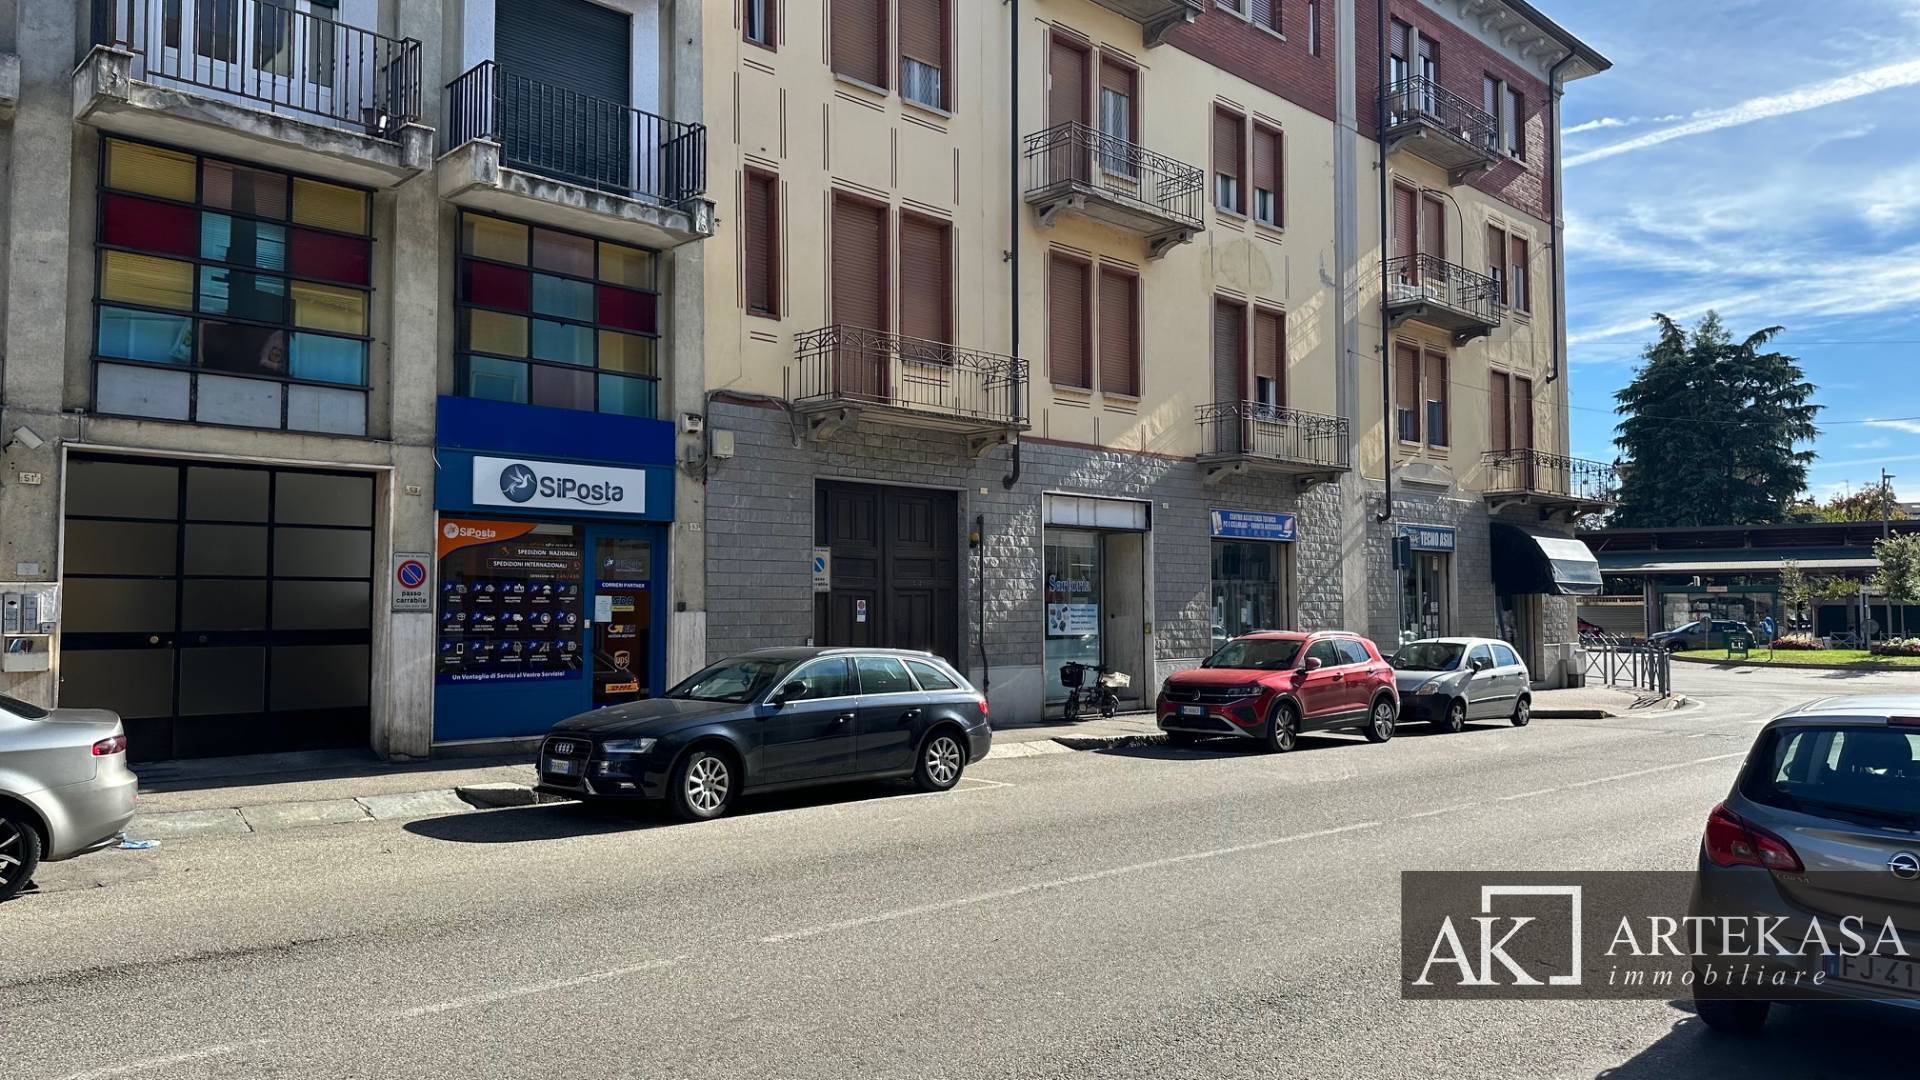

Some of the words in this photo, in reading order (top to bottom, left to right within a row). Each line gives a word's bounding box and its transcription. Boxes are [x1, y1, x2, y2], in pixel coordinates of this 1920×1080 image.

[540, 476, 624, 504] SiPosta
[459, 526, 496, 538] SiPosta
[1440, 532, 1453, 547] ASIA
[615, 654, 629, 667] ups
[452, 672, 461, 680] Un
[490, 671, 496, 679] di
[496, 671, 516, 679] Servizi
